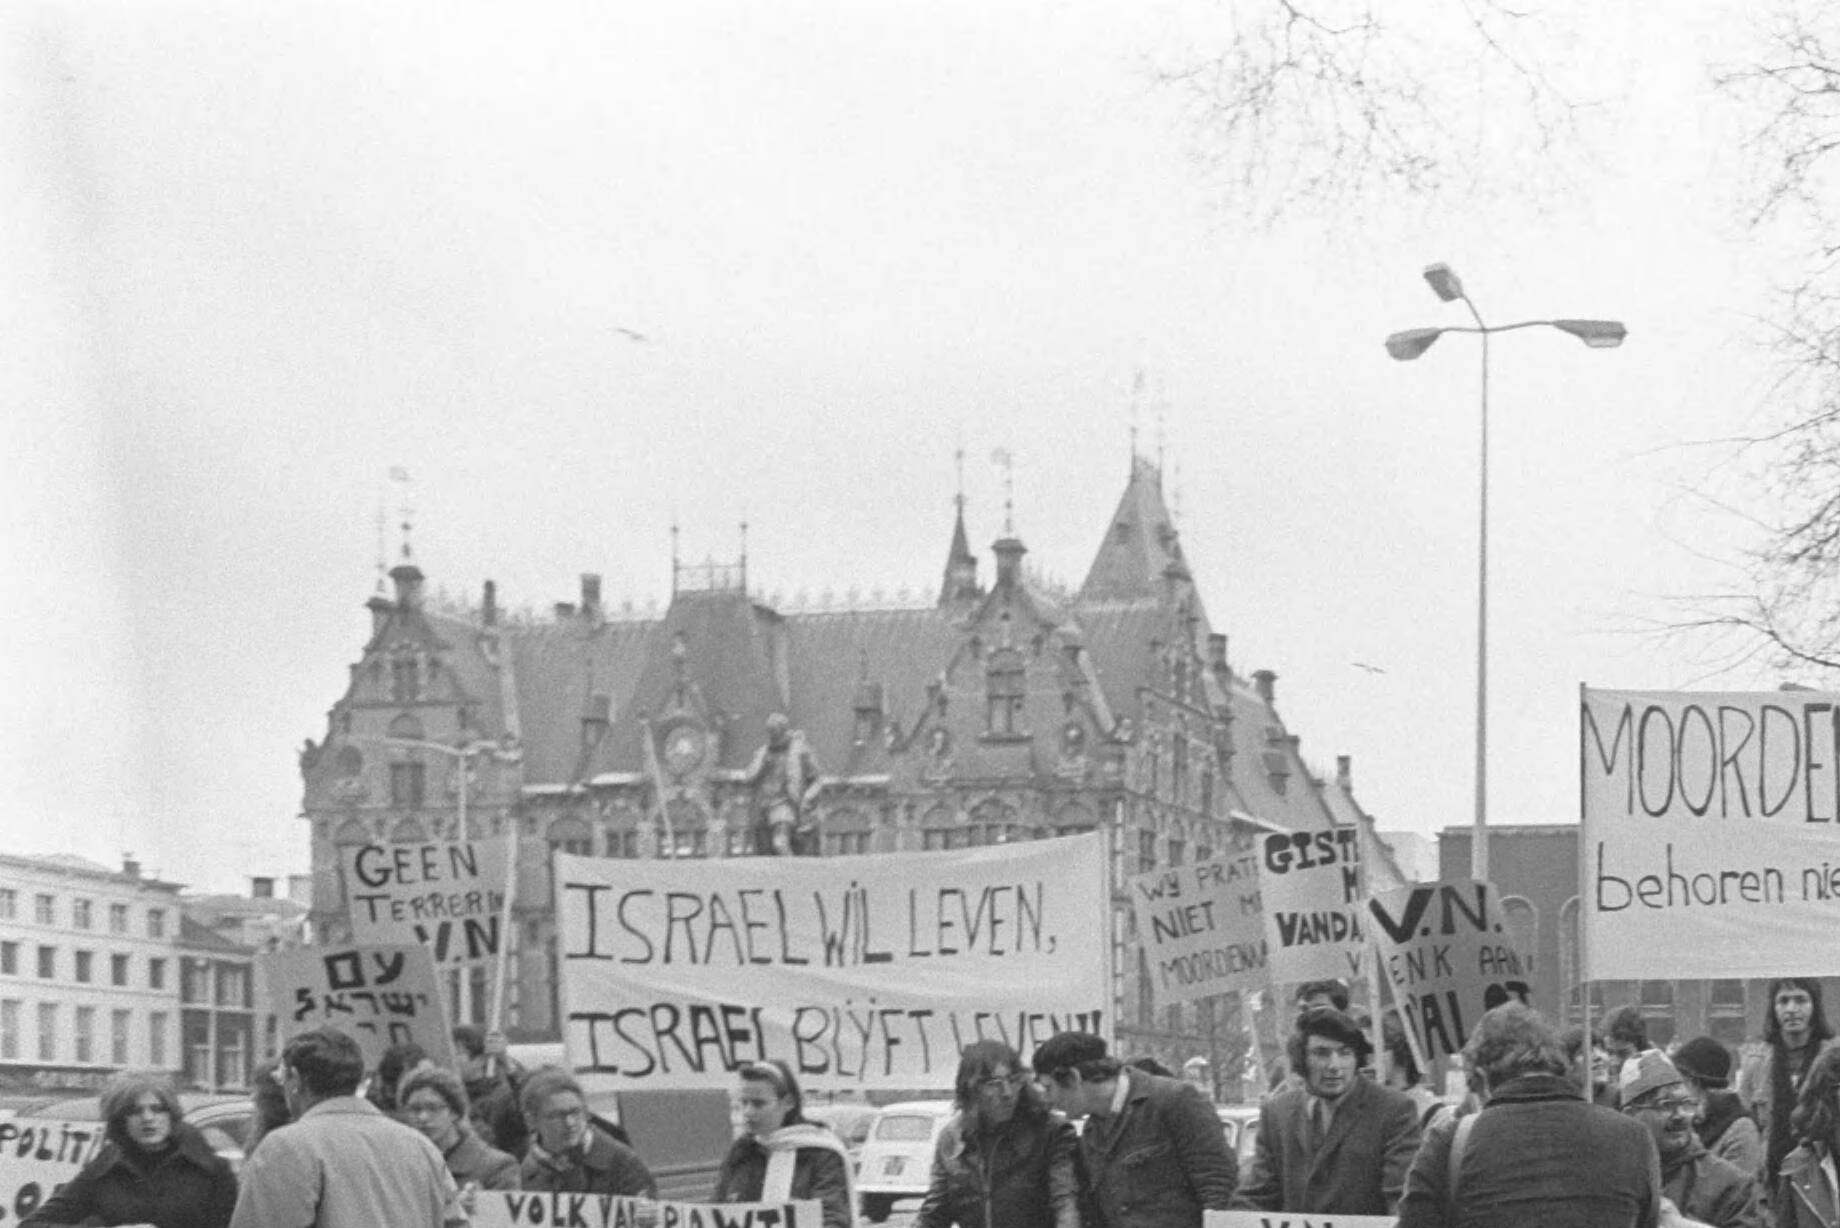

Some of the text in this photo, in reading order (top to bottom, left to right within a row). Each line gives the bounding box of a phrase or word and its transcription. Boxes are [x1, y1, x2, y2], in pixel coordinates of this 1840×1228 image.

[355, 844, 478, 887] GEEN
[1597, 841, 1784, 911] behoren
[565, 880, 1056, 967] ISRAEL WIL LEVEN,
[1151, 901, 1216, 944] NIET
[1369, 884, 1503, 944] V.N.
[322, 950, 406, 992] עם
[568, 1003, 768, 1078] ISRAEL
[505, 1192, 587, 1228] VOLK
